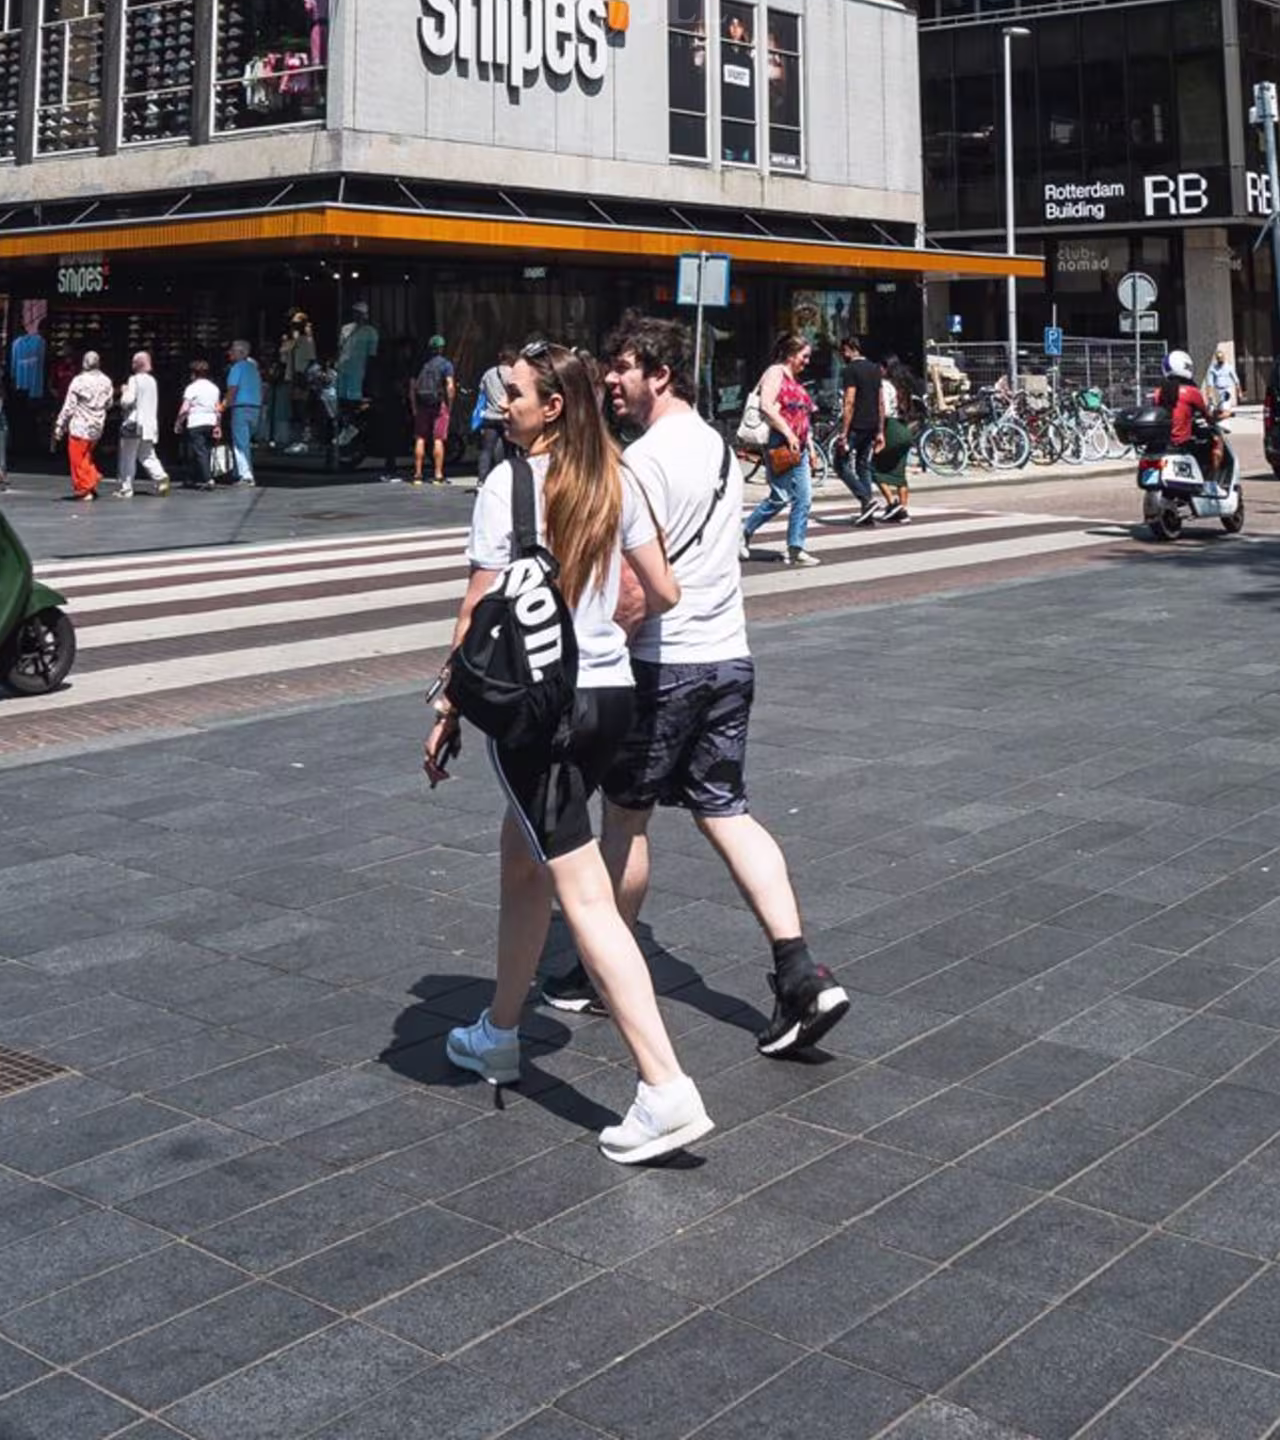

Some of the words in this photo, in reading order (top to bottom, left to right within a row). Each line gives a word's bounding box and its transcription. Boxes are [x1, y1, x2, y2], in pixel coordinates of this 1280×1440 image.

[1045, 181, 1124, 201] Rotterdam
[1144, 173, 1208, 216] RB
[1045, 202, 1106, 220] Building
[1057, 256, 1110, 272] nomad
[58, 266, 104, 298] snipes
